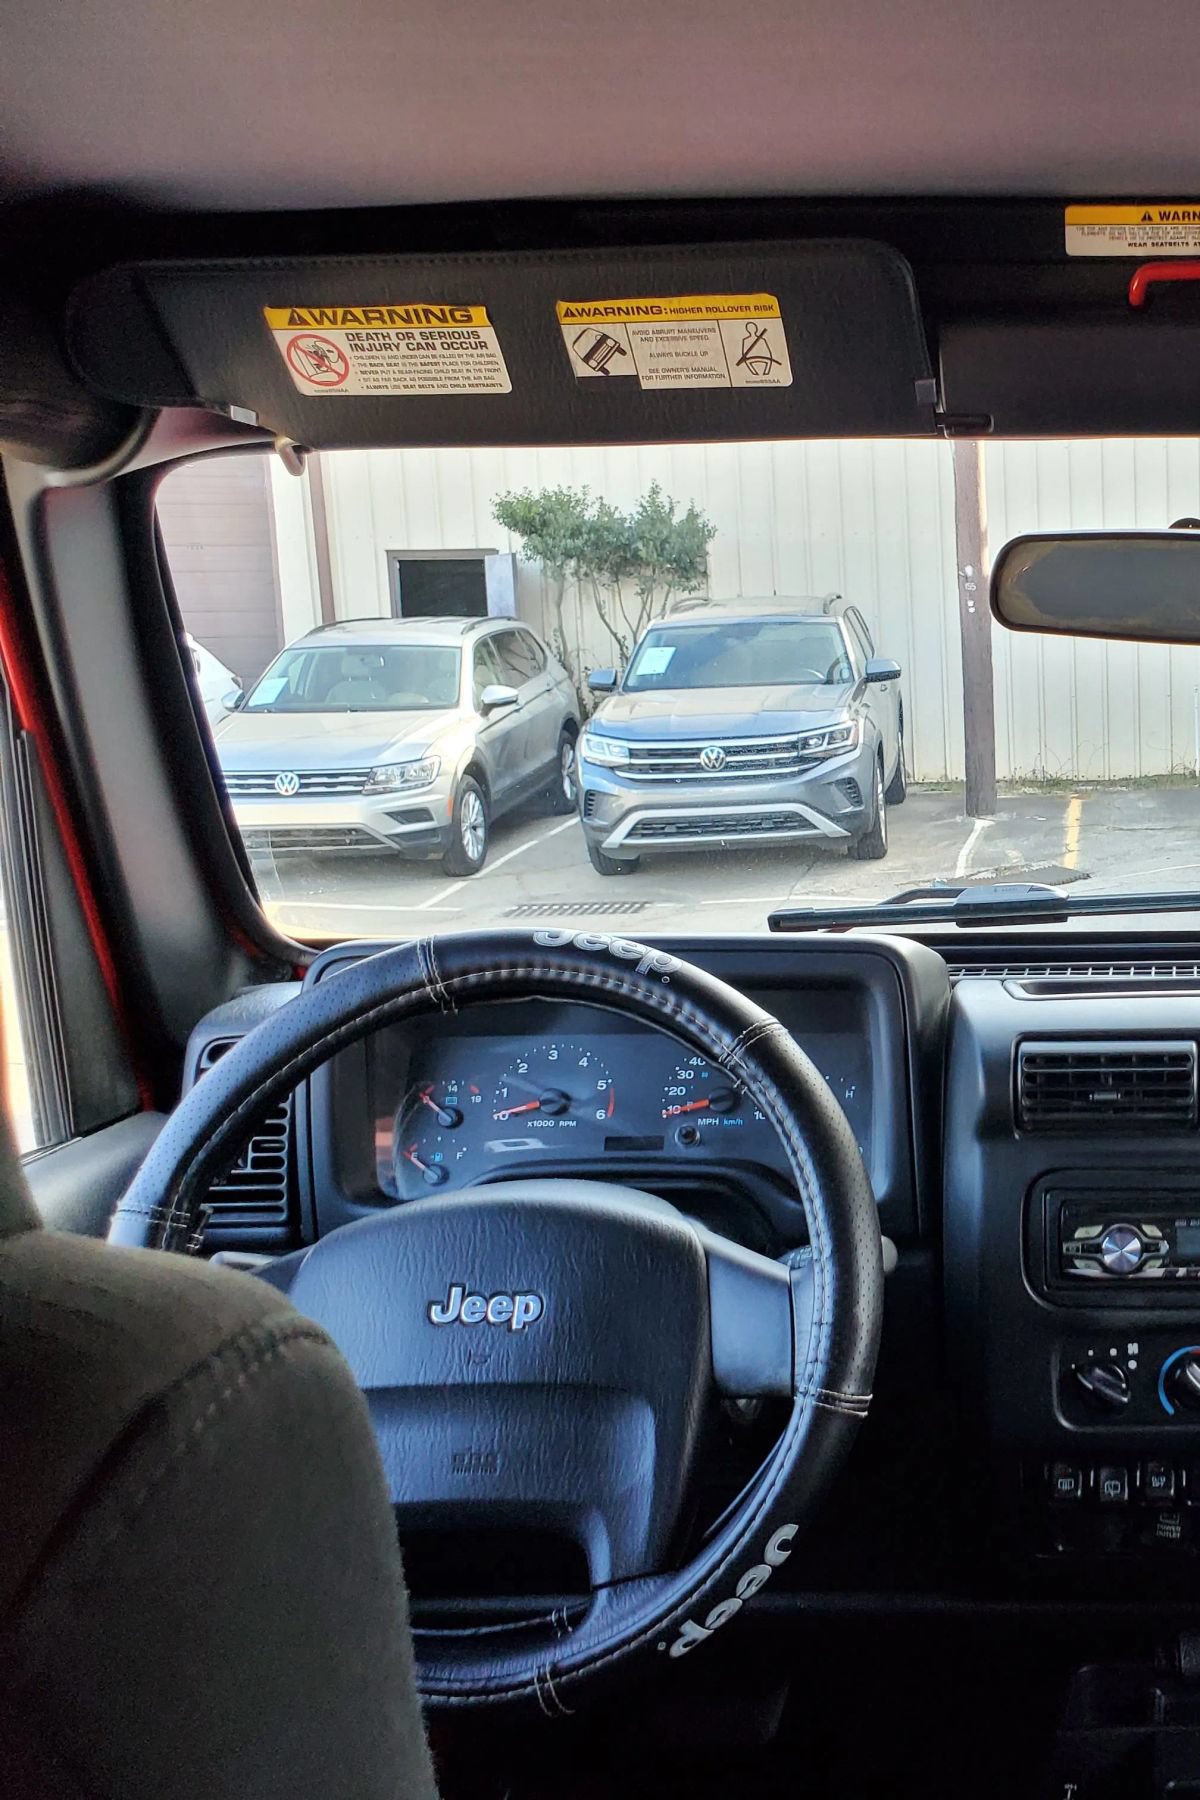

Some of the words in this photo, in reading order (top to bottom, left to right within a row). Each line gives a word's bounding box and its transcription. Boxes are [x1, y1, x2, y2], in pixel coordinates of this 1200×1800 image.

[576, 304, 668, 317] WARNING:
[670, 306, 701, 314] HIGHER
[705, 305, 751, 314] ROLLOVER
[754, 304, 775, 313] RISK
[306, 308, 474, 327] WARNING
[345, 332, 391, 343] DEATH
[396, 331, 416, 342] OR
[420, 330, 481, 341] SERIOUS
[349, 342, 401, 353] INJURY
[406, 341, 436, 352] CAN
[441, 340, 488, 350] OCCUR
[533, 930, 683, 975] Jeep
[548, 1049, 559, 1061] 3
[578, 1056, 590, 1067] 4
[518, 1063, 529, 1073] 2
[677, 1070, 694, 1079] 30
[447, 1085, 458, 1093] 14
[597, 1080, 607, 1090] 5
[501, 1088, 508, 1097] 1
[668, 1086, 686, 1096] 20
[845, 1090, 854, 1099] H
[596, 1109, 606, 1120] 6
[667, 1105, 681, 1115] 10
[527, 1120, 555, 1128] x1000
[559, 1120, 577, 1128] RPM
[697, 1118, 719, 1126] MPH
[723, 1118, 743, 1127] km/h
[456, 1152, 464, 1160] F
[430, 1287, 543, 1329] Jeep
[669, 1523, 799, 1658] Jeep
